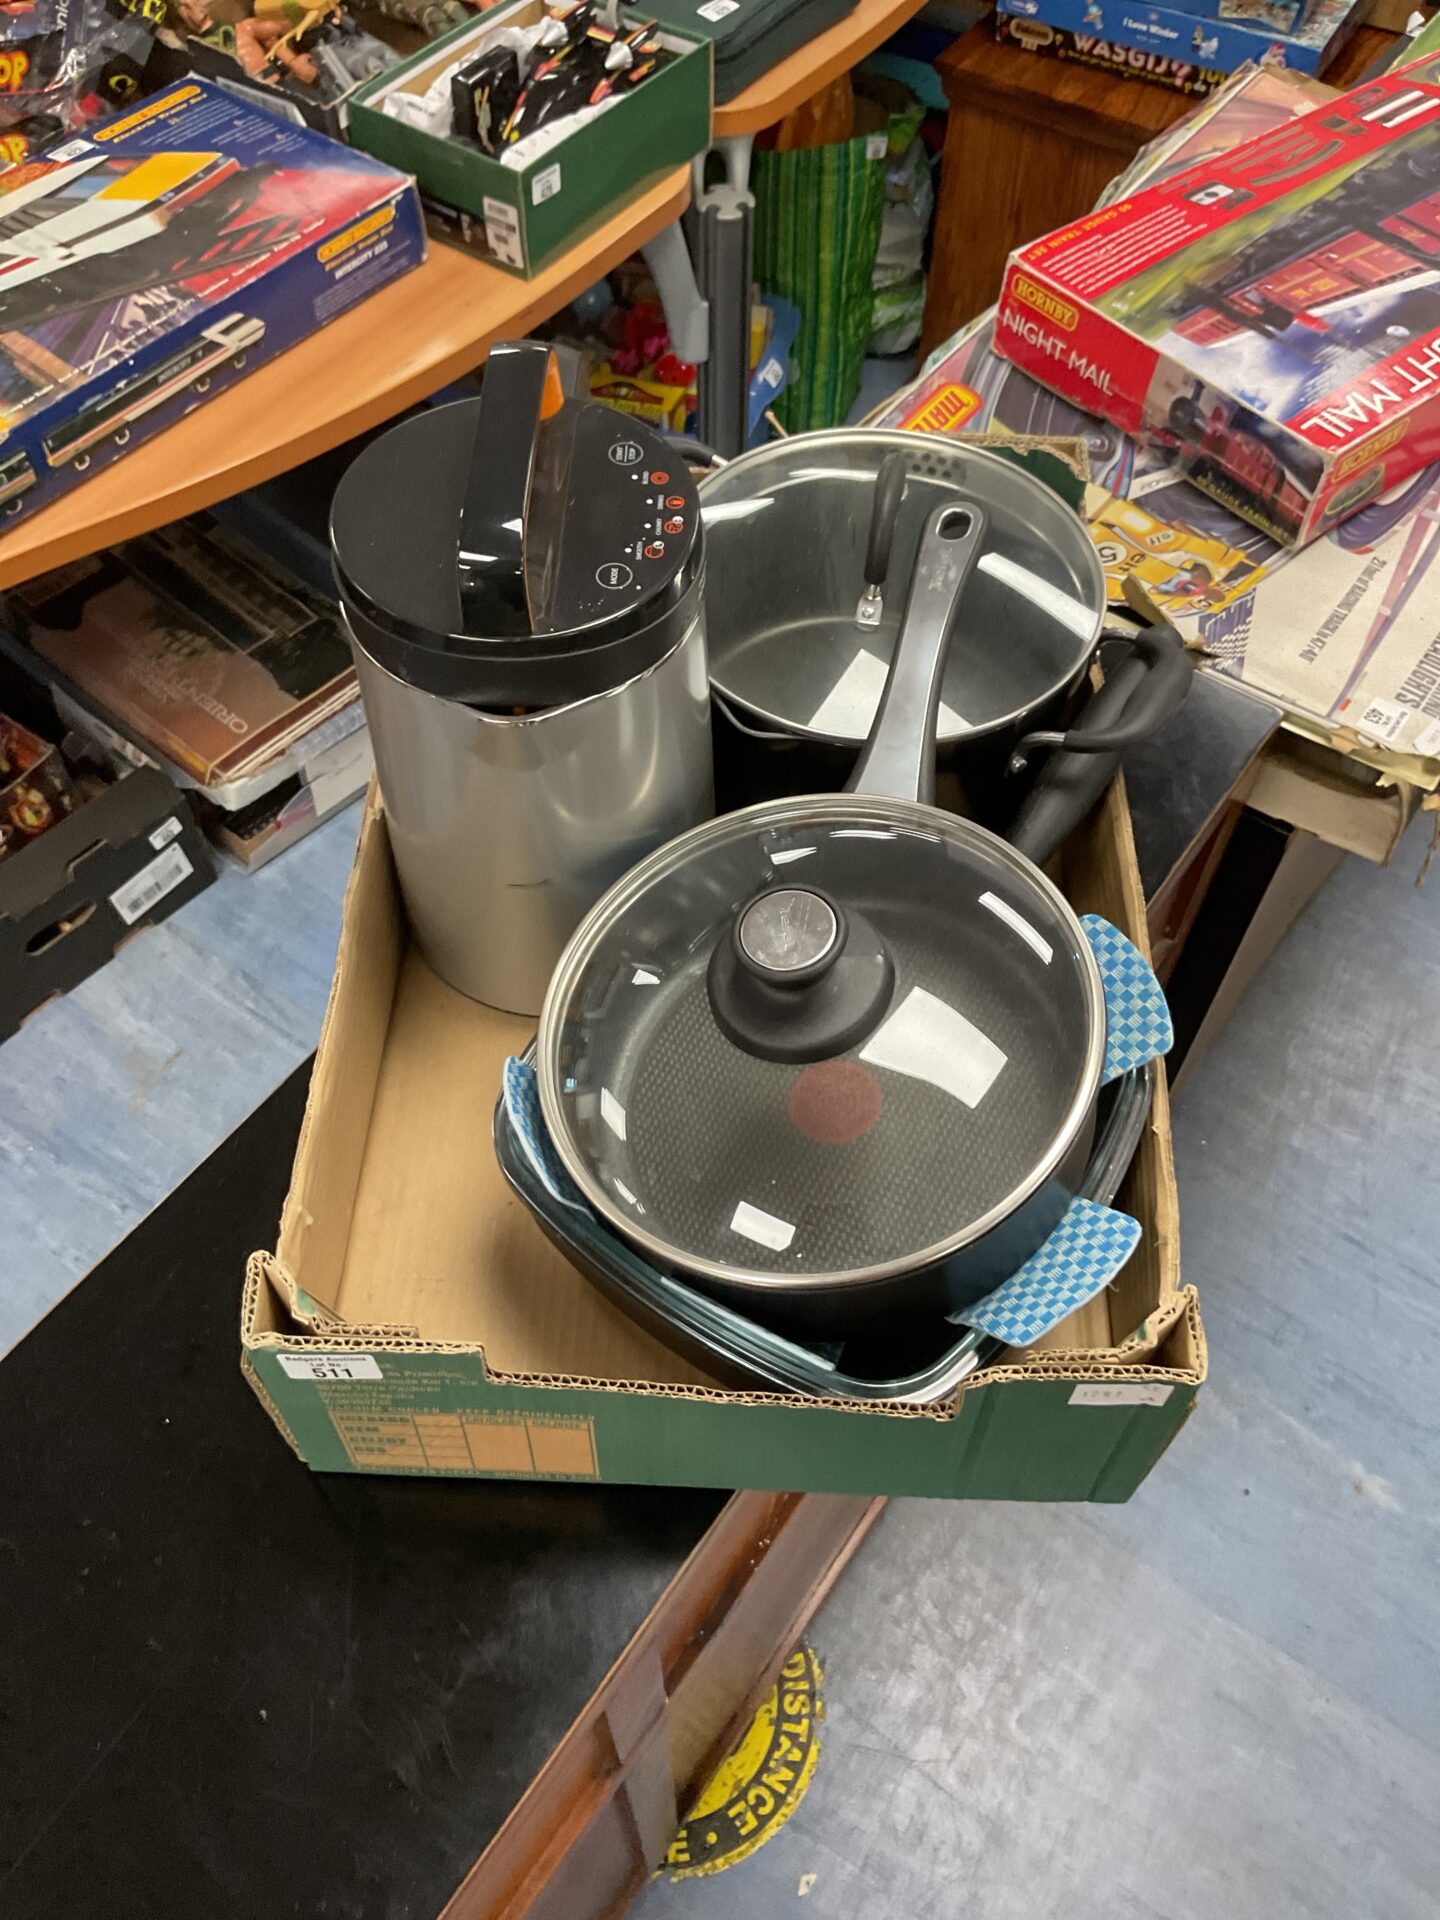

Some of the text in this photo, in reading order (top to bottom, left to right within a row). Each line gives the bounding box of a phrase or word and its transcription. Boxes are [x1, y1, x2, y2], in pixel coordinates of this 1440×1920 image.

[1016, 278, 1073, 326] HORNBY
[1002, 307, 1114, 397] NIGHT MAIL
[1300, 378, 1404, 439] MAIL
[615, 446, 624, 461] START
[628, 447, 637, 460] STOP
[635, 541, 644, 561] SMOOTH
[1098, 545, 1118, 564] 5
[609, 567, 619, 585] MODE
[311, 1367, 354, 1378] 511
[727, 1651, 811, 1836] DISTANCE
